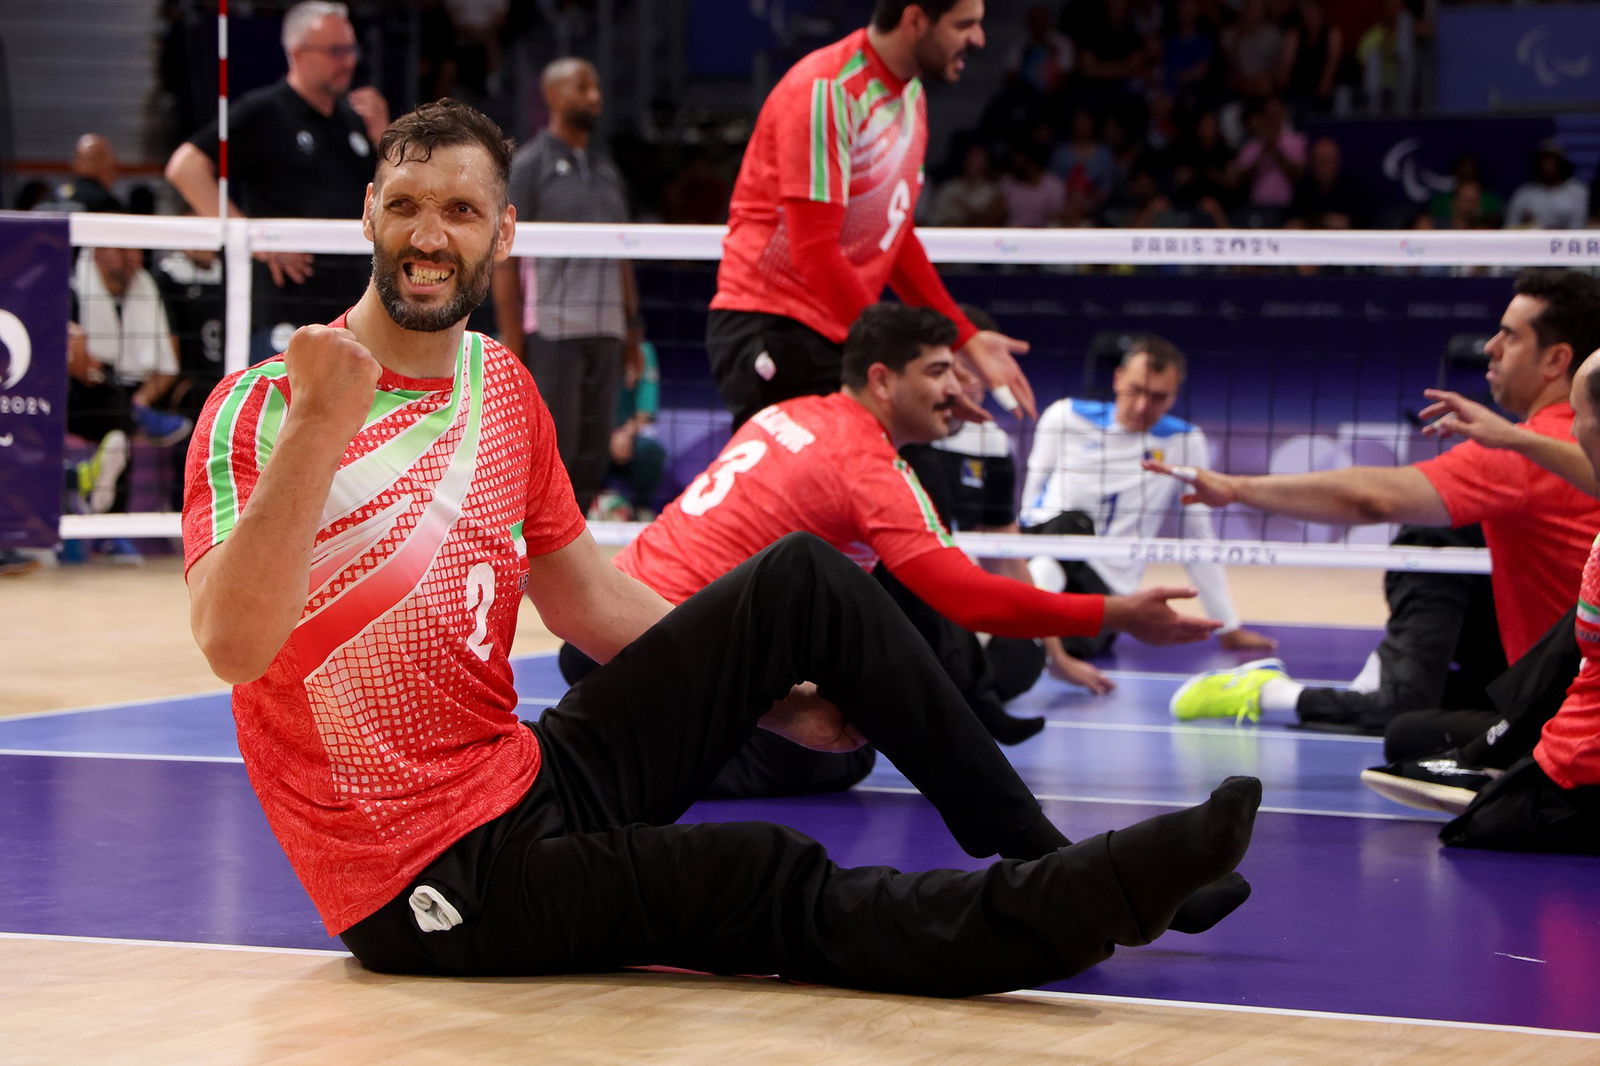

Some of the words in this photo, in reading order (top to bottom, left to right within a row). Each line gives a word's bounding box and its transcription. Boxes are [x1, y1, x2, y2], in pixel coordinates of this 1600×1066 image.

[879, 178, 910, 253] 9
[1131, 236, 1204, 254] PARIS
[1212, 236, 1280, 254] 2024
[680, 440, 768, 516] 3
[1129, 543, 1201, 564] PARIS
[1211, 545, 1278, 566] 2024
[466, 562, 495, 662] 2
